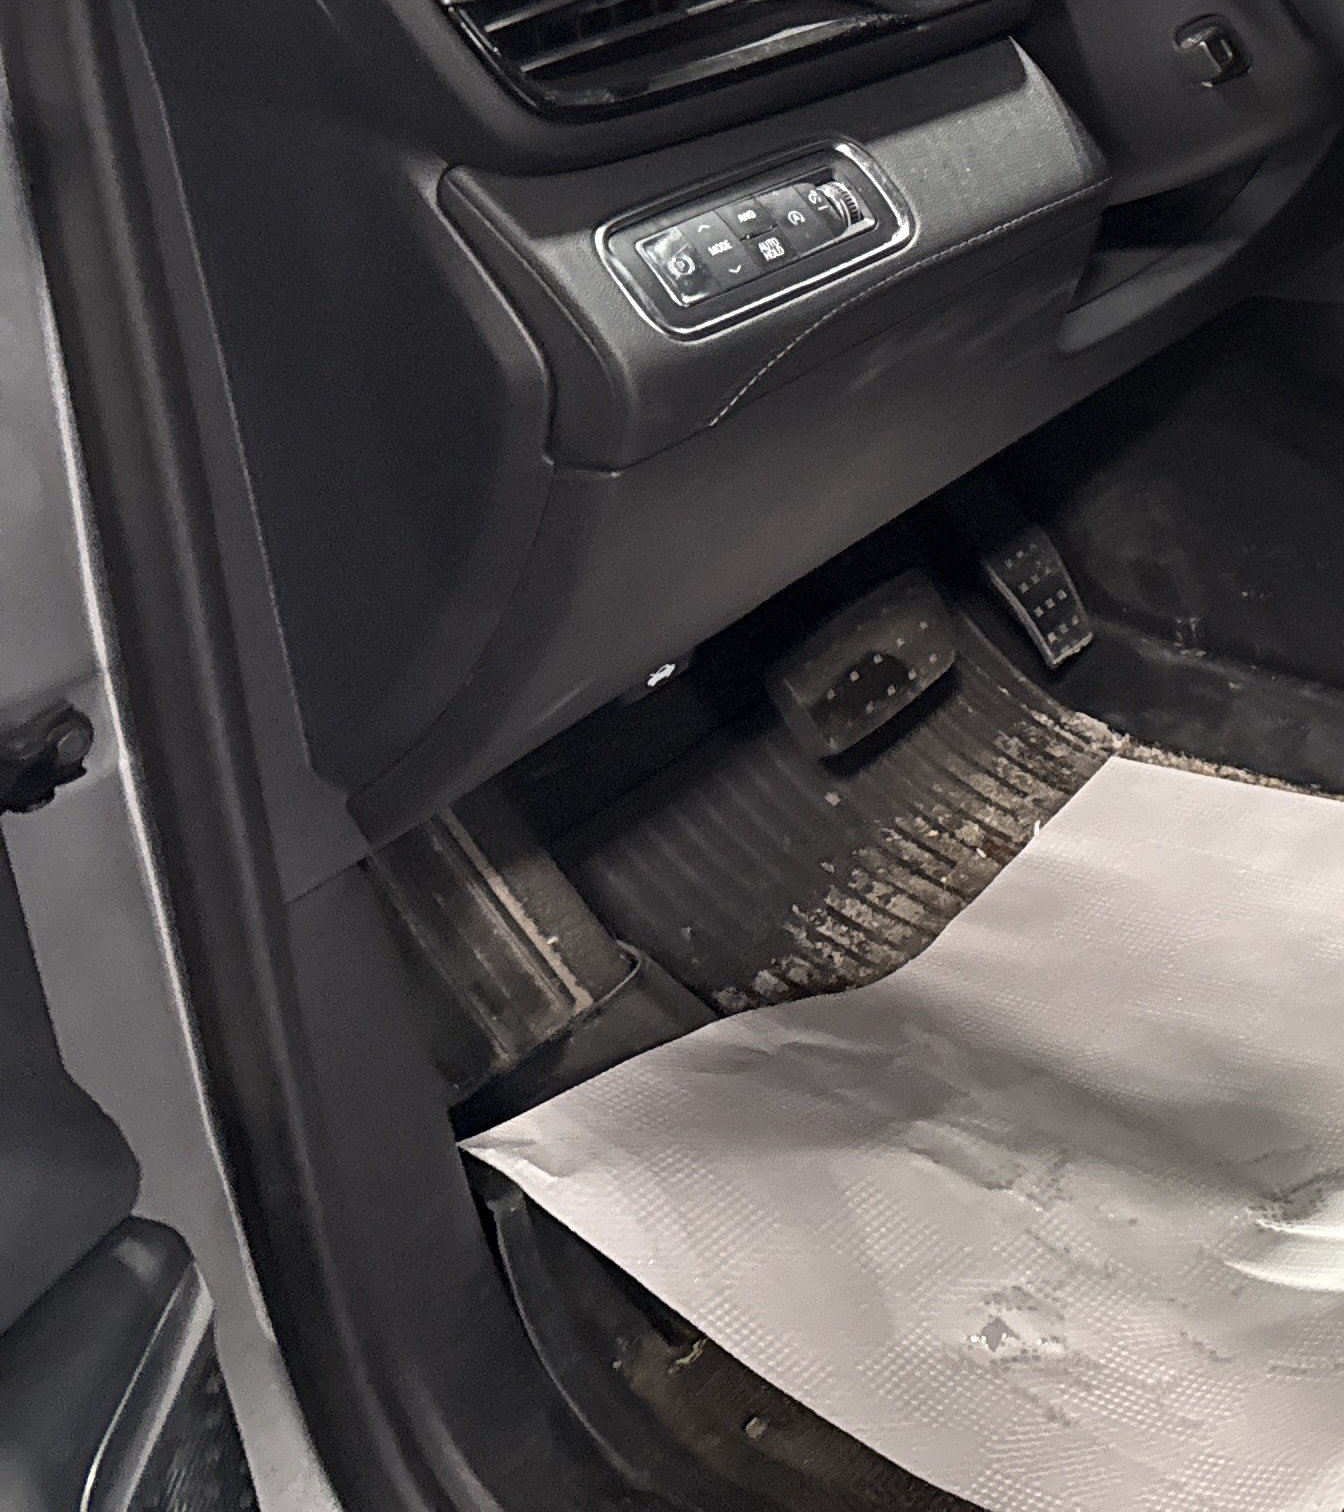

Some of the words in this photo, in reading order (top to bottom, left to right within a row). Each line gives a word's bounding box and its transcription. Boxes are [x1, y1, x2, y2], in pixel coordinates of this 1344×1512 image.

[707, 239, 733, 256] MODE
[758, 237, 780, 252] AUTO
[762, 247, 785, 262] HOLD
